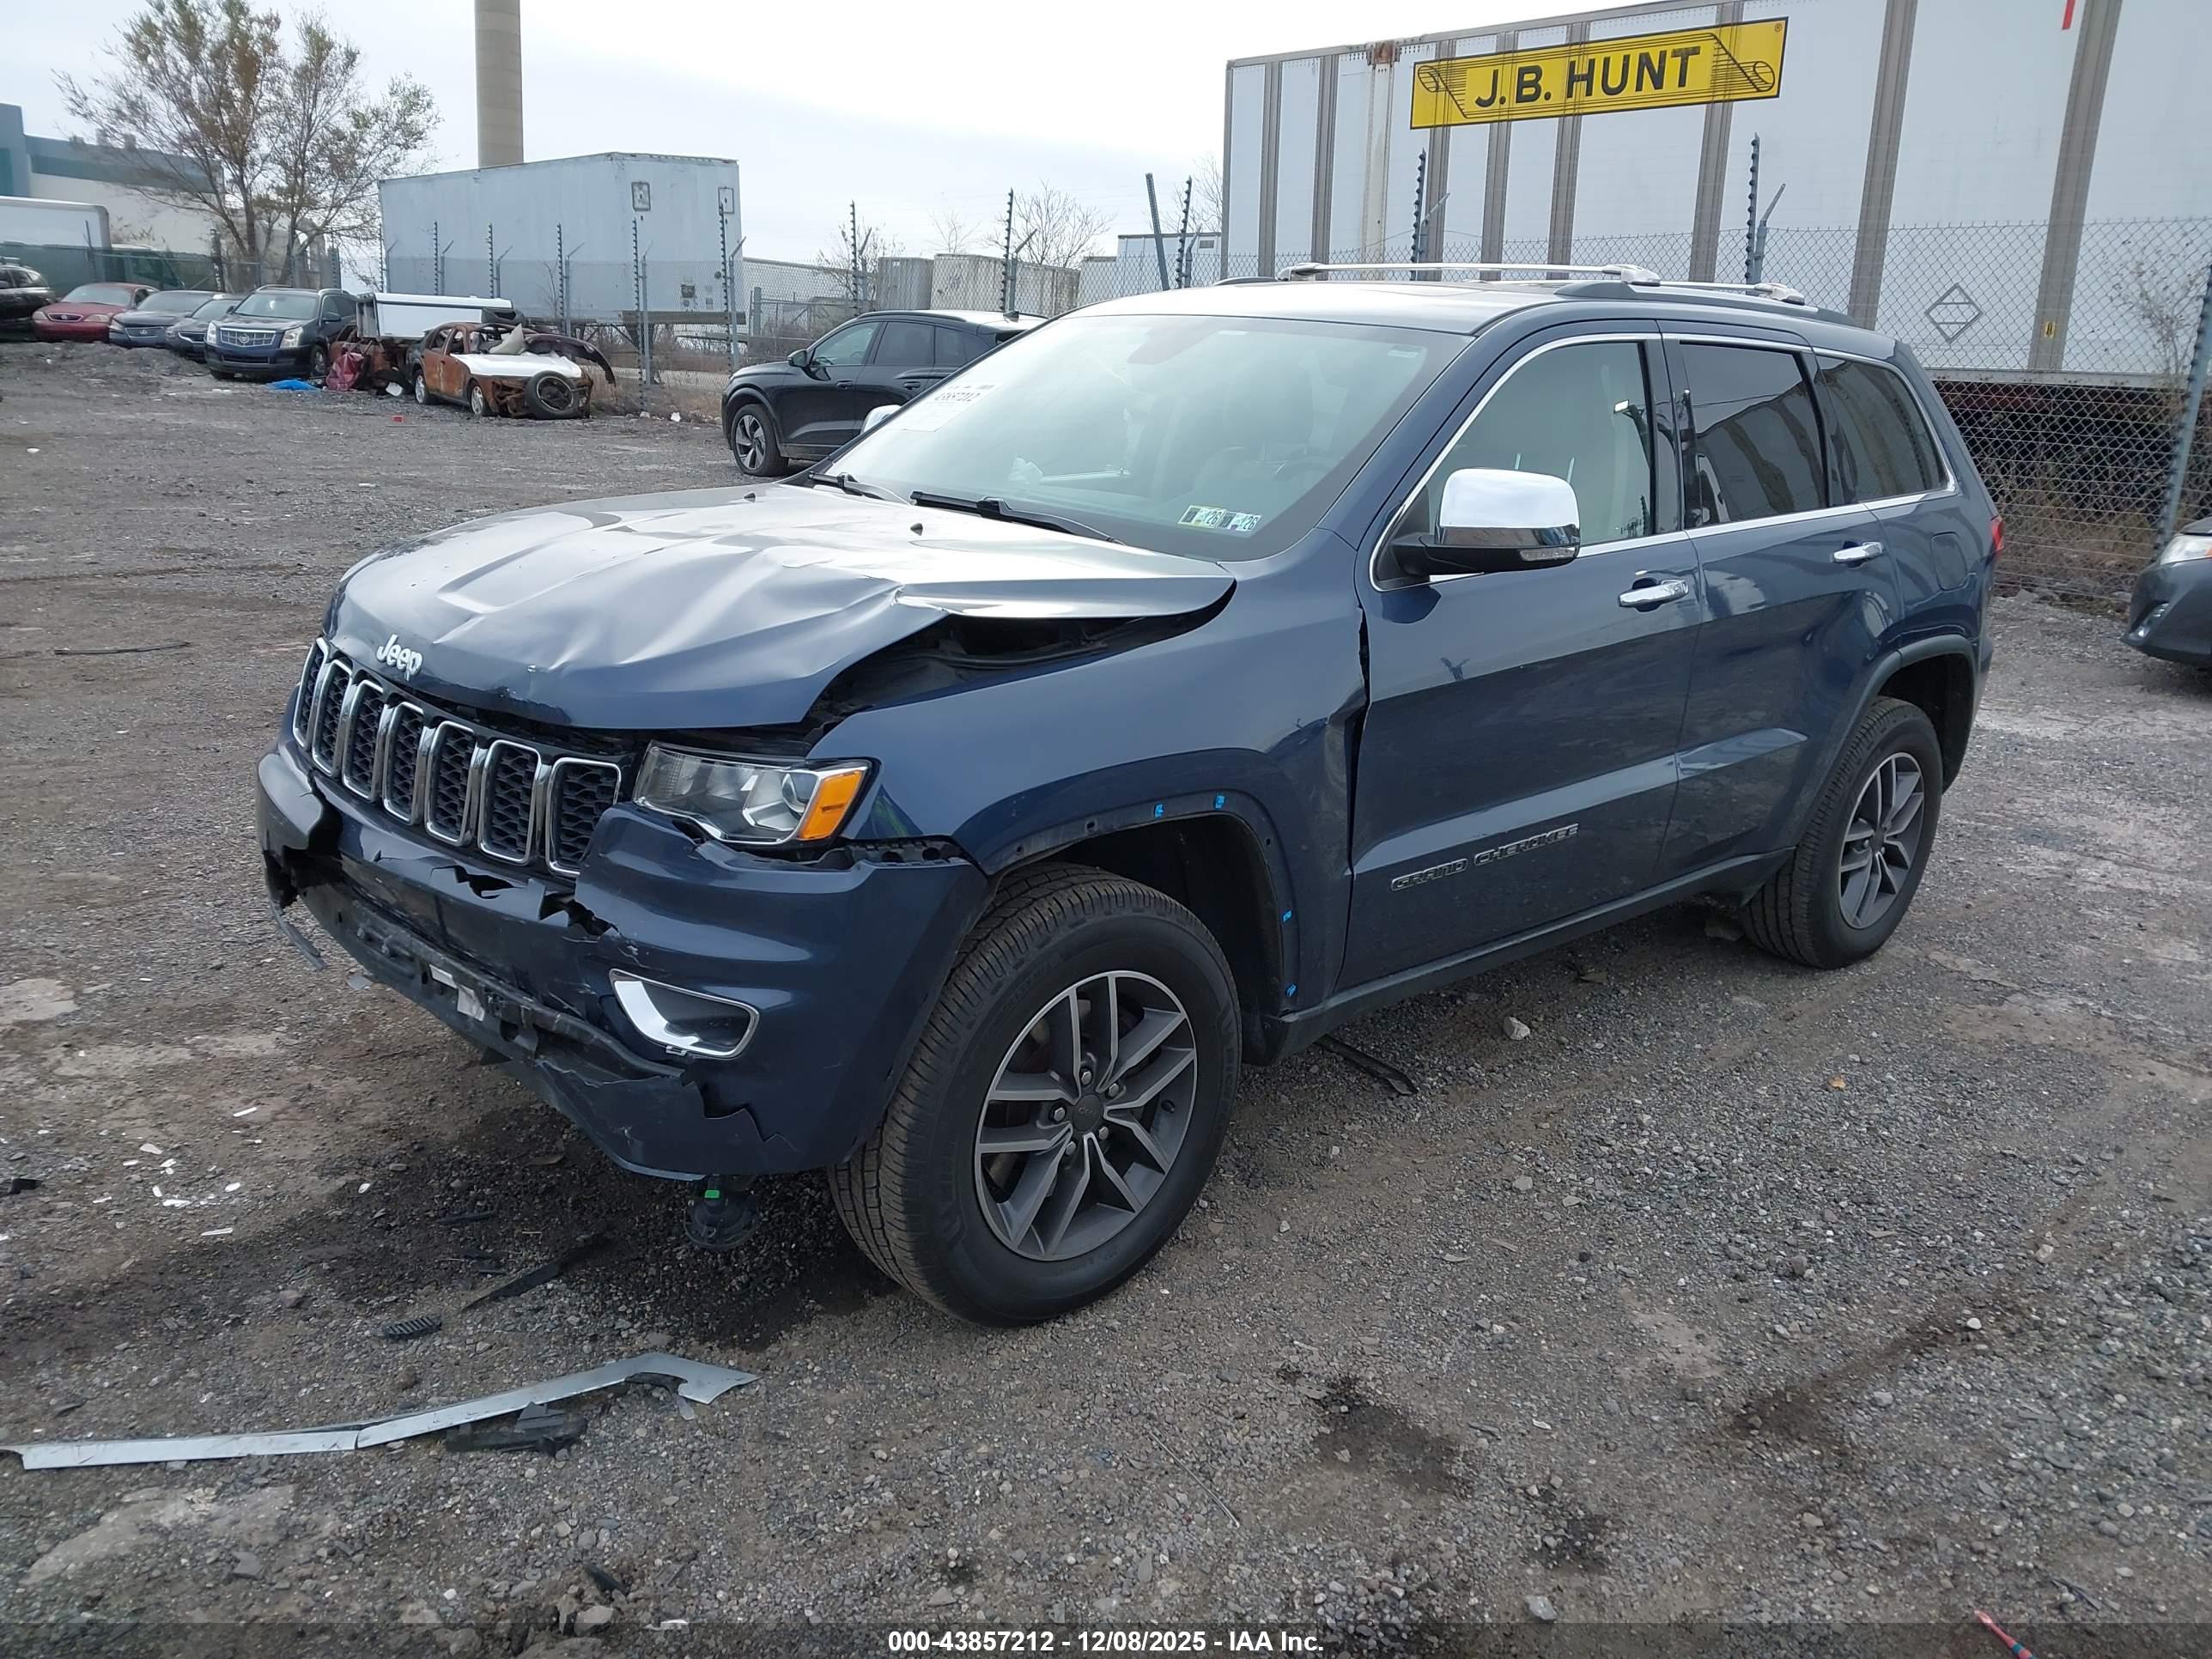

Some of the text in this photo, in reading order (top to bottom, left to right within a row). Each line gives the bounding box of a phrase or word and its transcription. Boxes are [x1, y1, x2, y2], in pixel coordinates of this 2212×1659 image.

[1474, 46, 1702, 108] J.B. HUNT
[1206, 510, 1223, 526] 26
[1243, 515, 1259, 531] 26
[376, 633, 422, 682] Jeep
[1390, 823, 1579, 891] GRAND CHEROKEE
